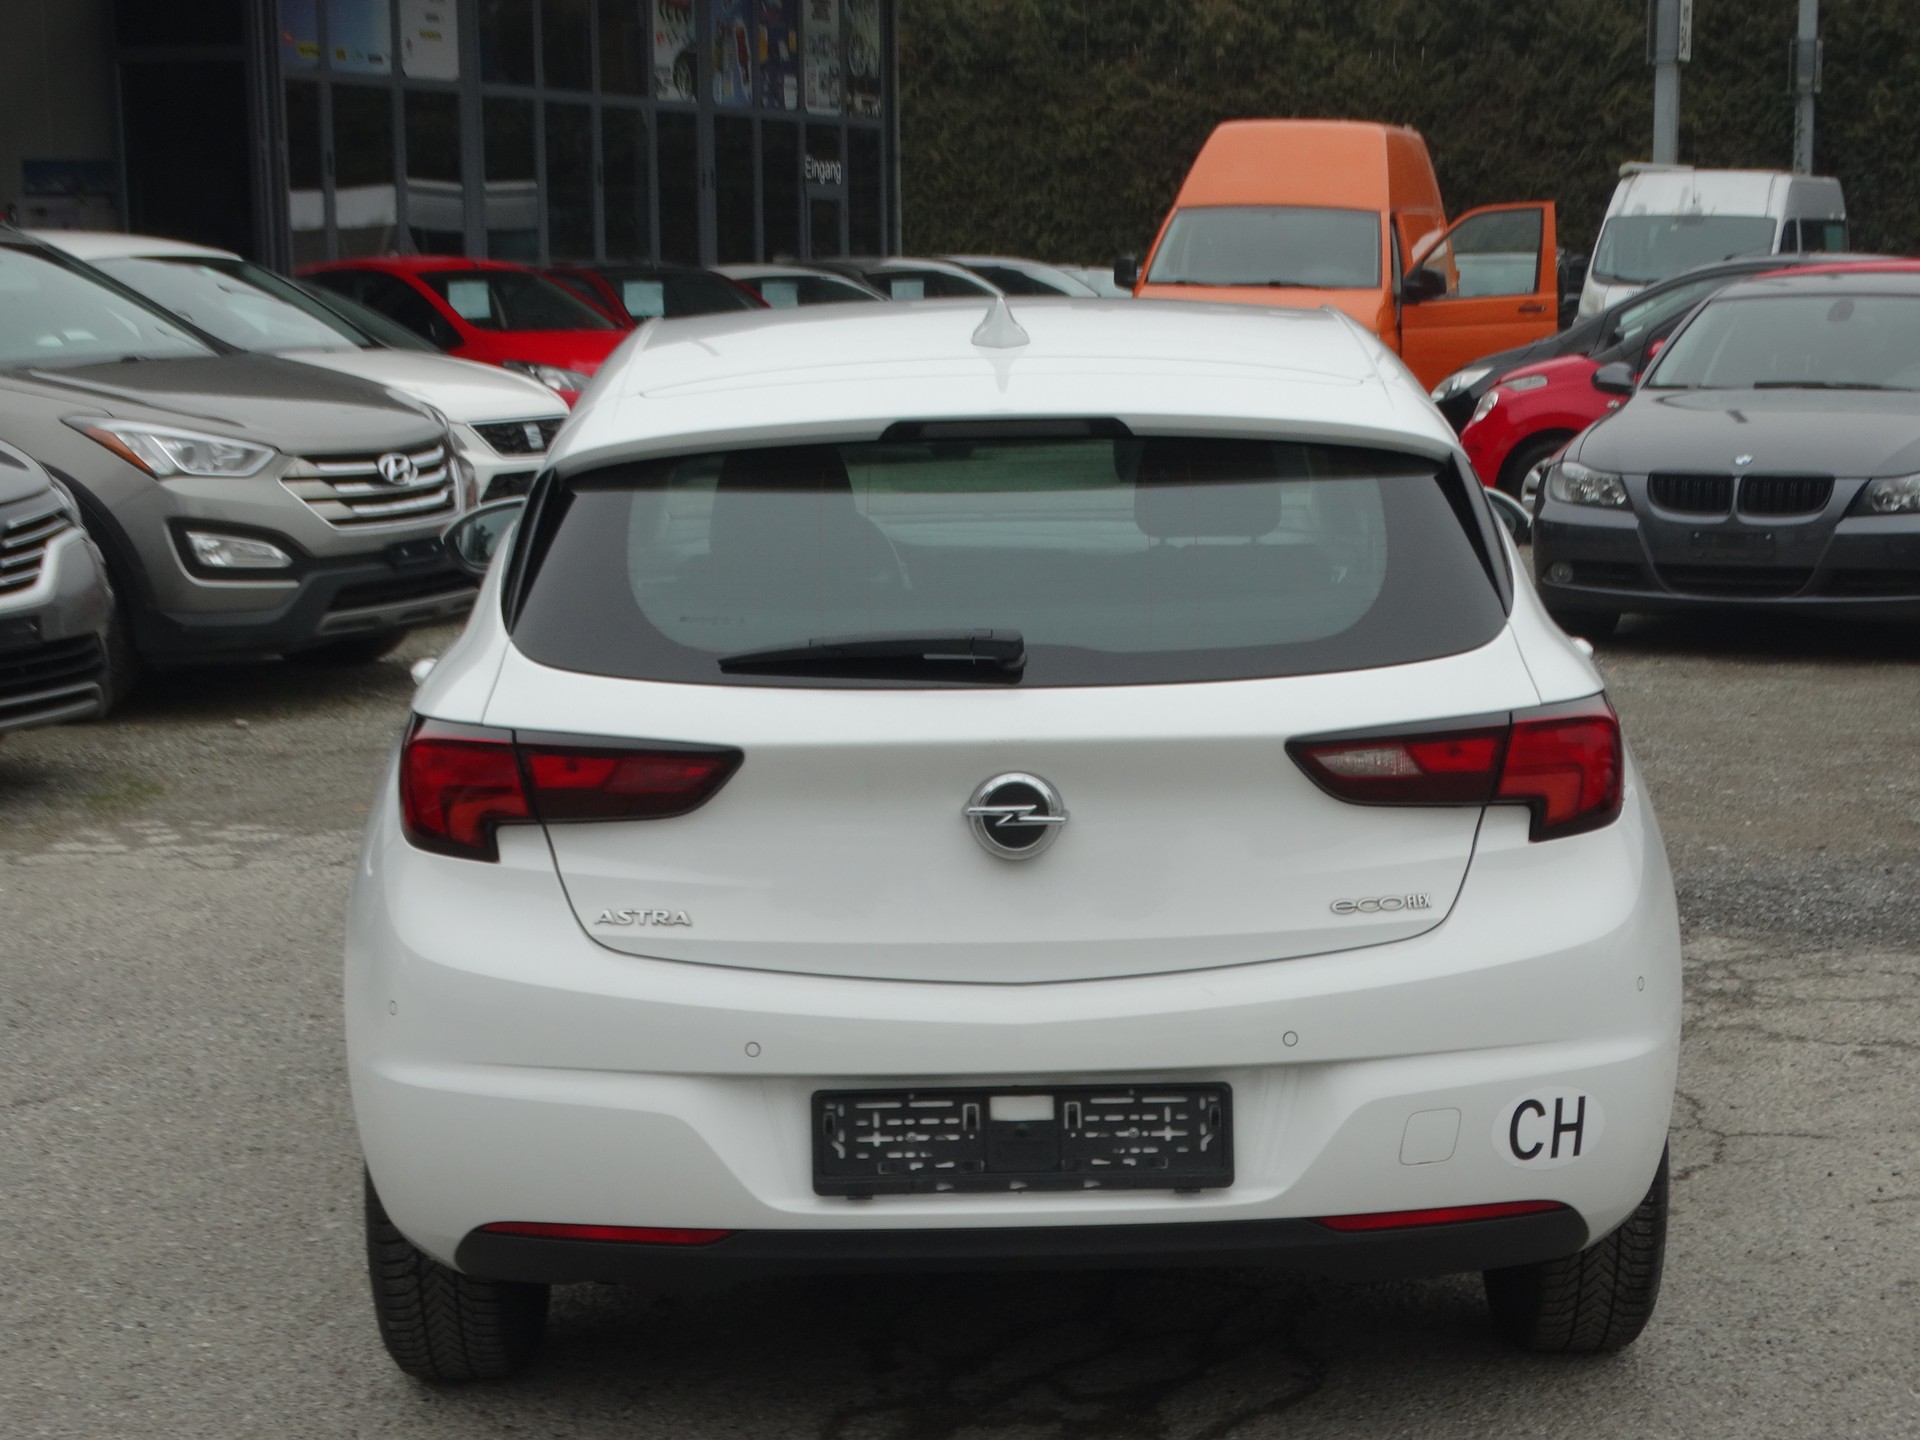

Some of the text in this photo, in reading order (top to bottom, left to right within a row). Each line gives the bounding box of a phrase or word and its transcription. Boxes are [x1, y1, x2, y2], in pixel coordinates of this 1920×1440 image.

[805, 155, 841, 185] Eingang
[595, 909, 693, 926] ASTRA
[1509, 1096, 1586, 1160] CH
